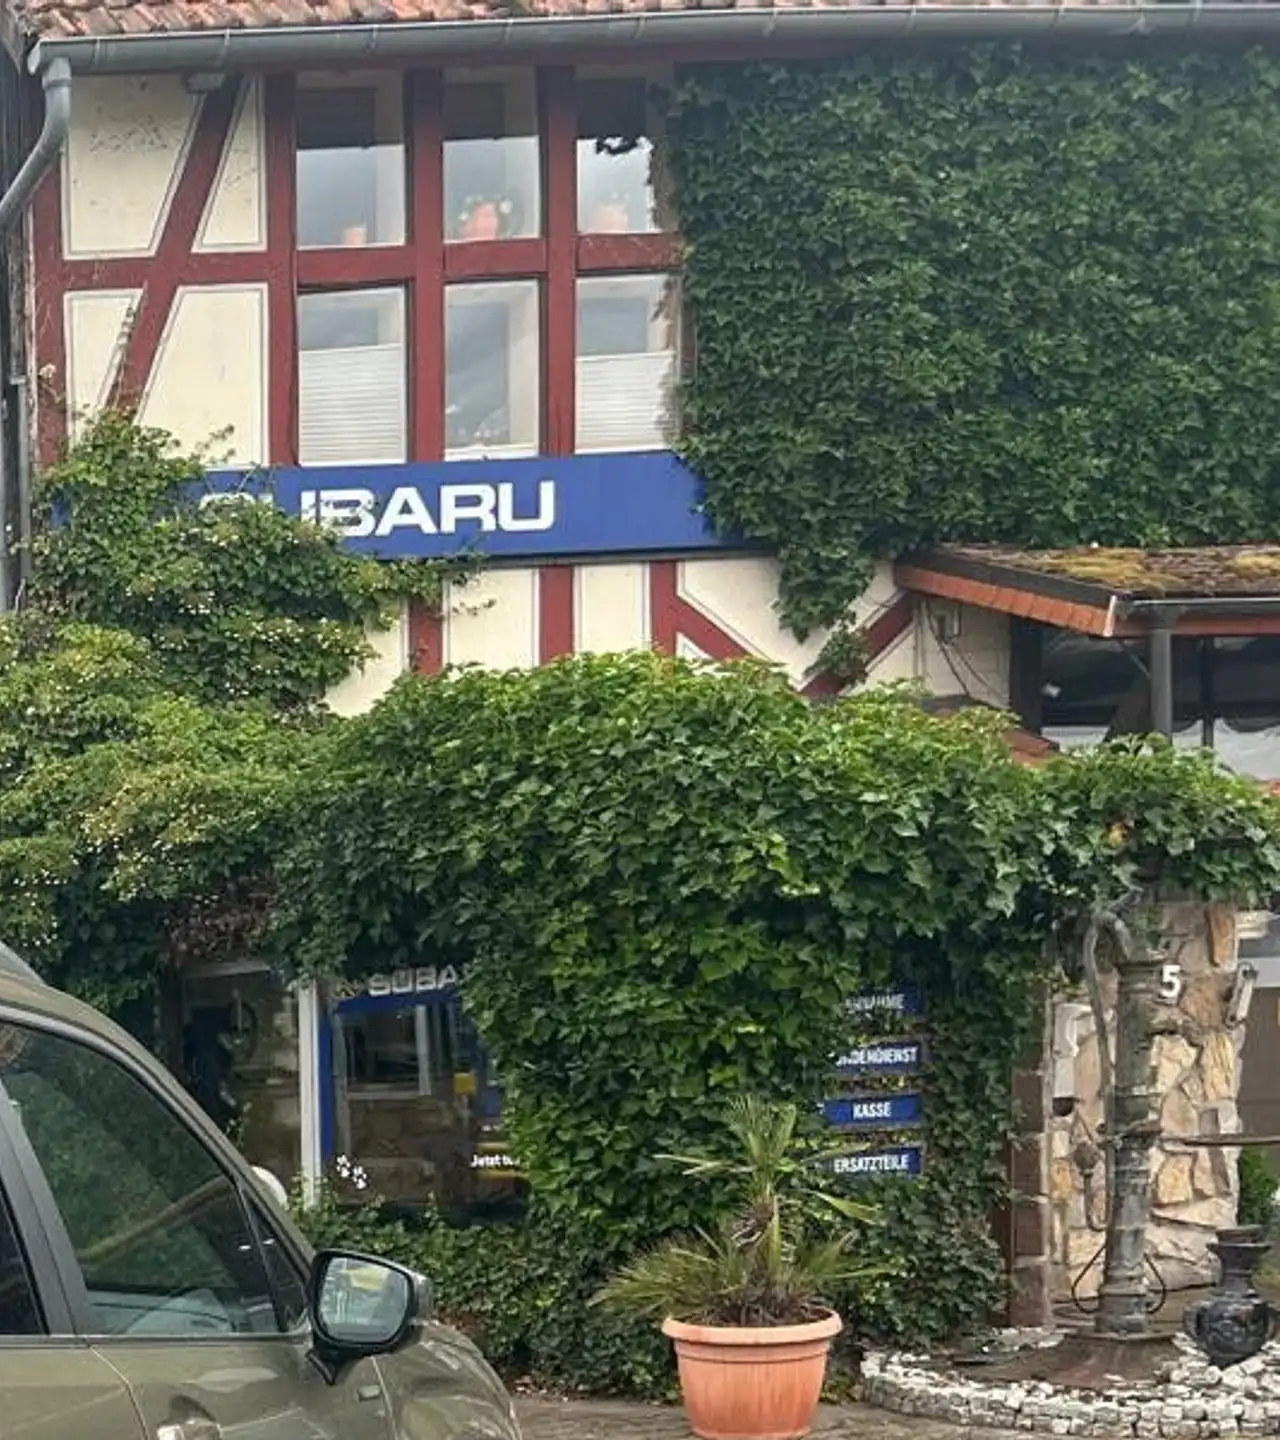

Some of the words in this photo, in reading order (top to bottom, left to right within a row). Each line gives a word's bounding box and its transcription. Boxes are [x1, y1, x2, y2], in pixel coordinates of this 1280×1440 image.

[199, 480, 555, 538] BARU
[1161, 964, 1181, 998] 5
[852, 1101, 892, 1120] KASSE
[833, 1154, 910, 1174] ERSATZTEILE
